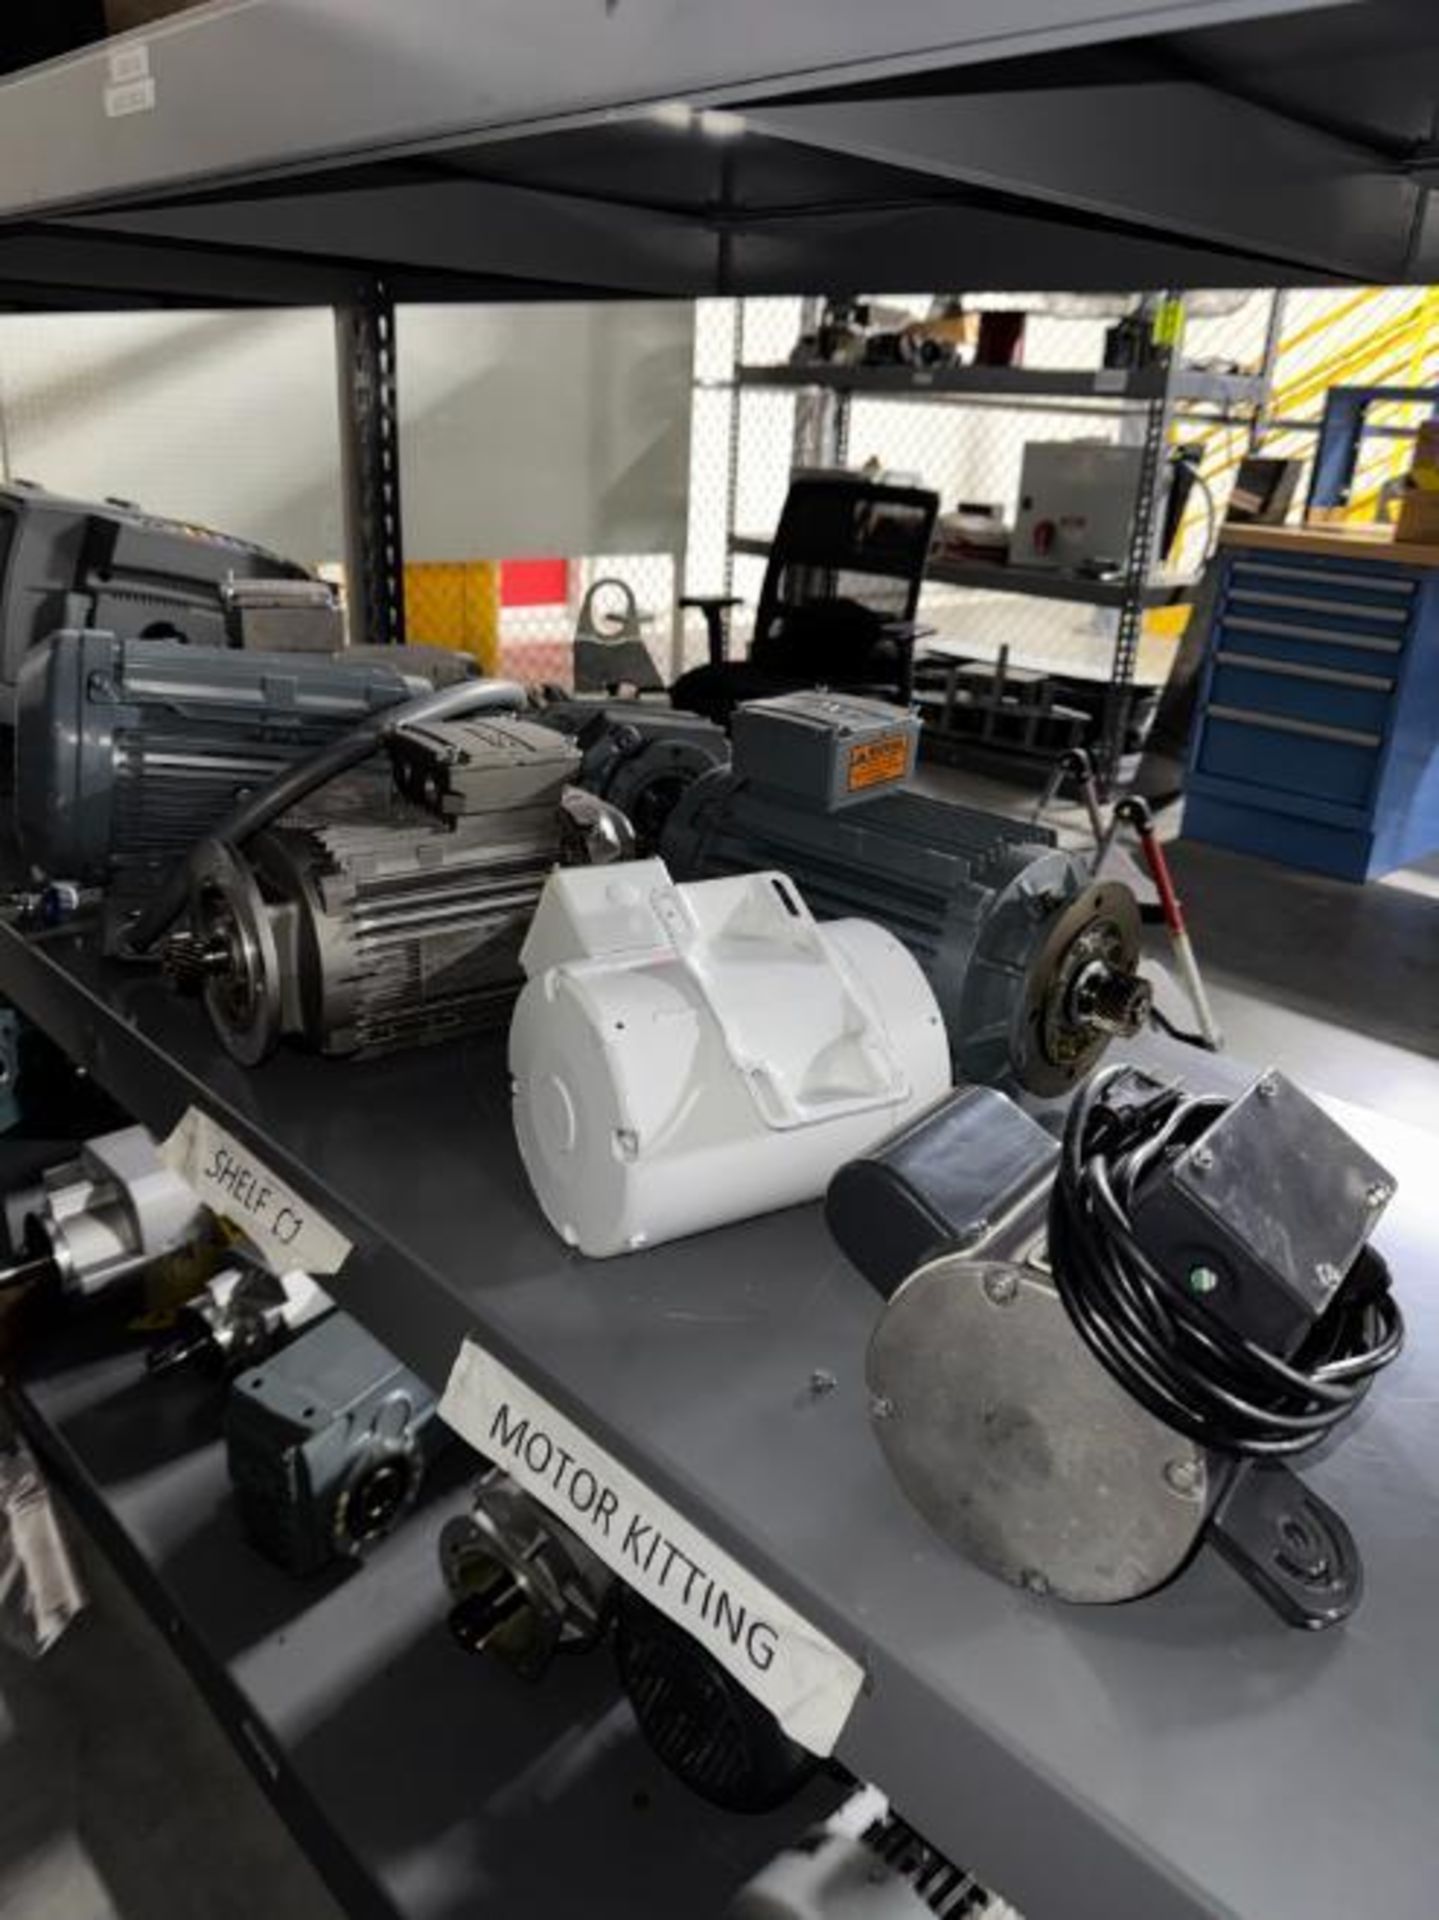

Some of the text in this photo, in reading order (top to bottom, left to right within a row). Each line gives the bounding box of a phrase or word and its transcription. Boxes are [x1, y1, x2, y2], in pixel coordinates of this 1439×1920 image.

[205, 1149, 272, 1214] SHELF
[489, 1403, 780, 1671] MOTOR KITTING
